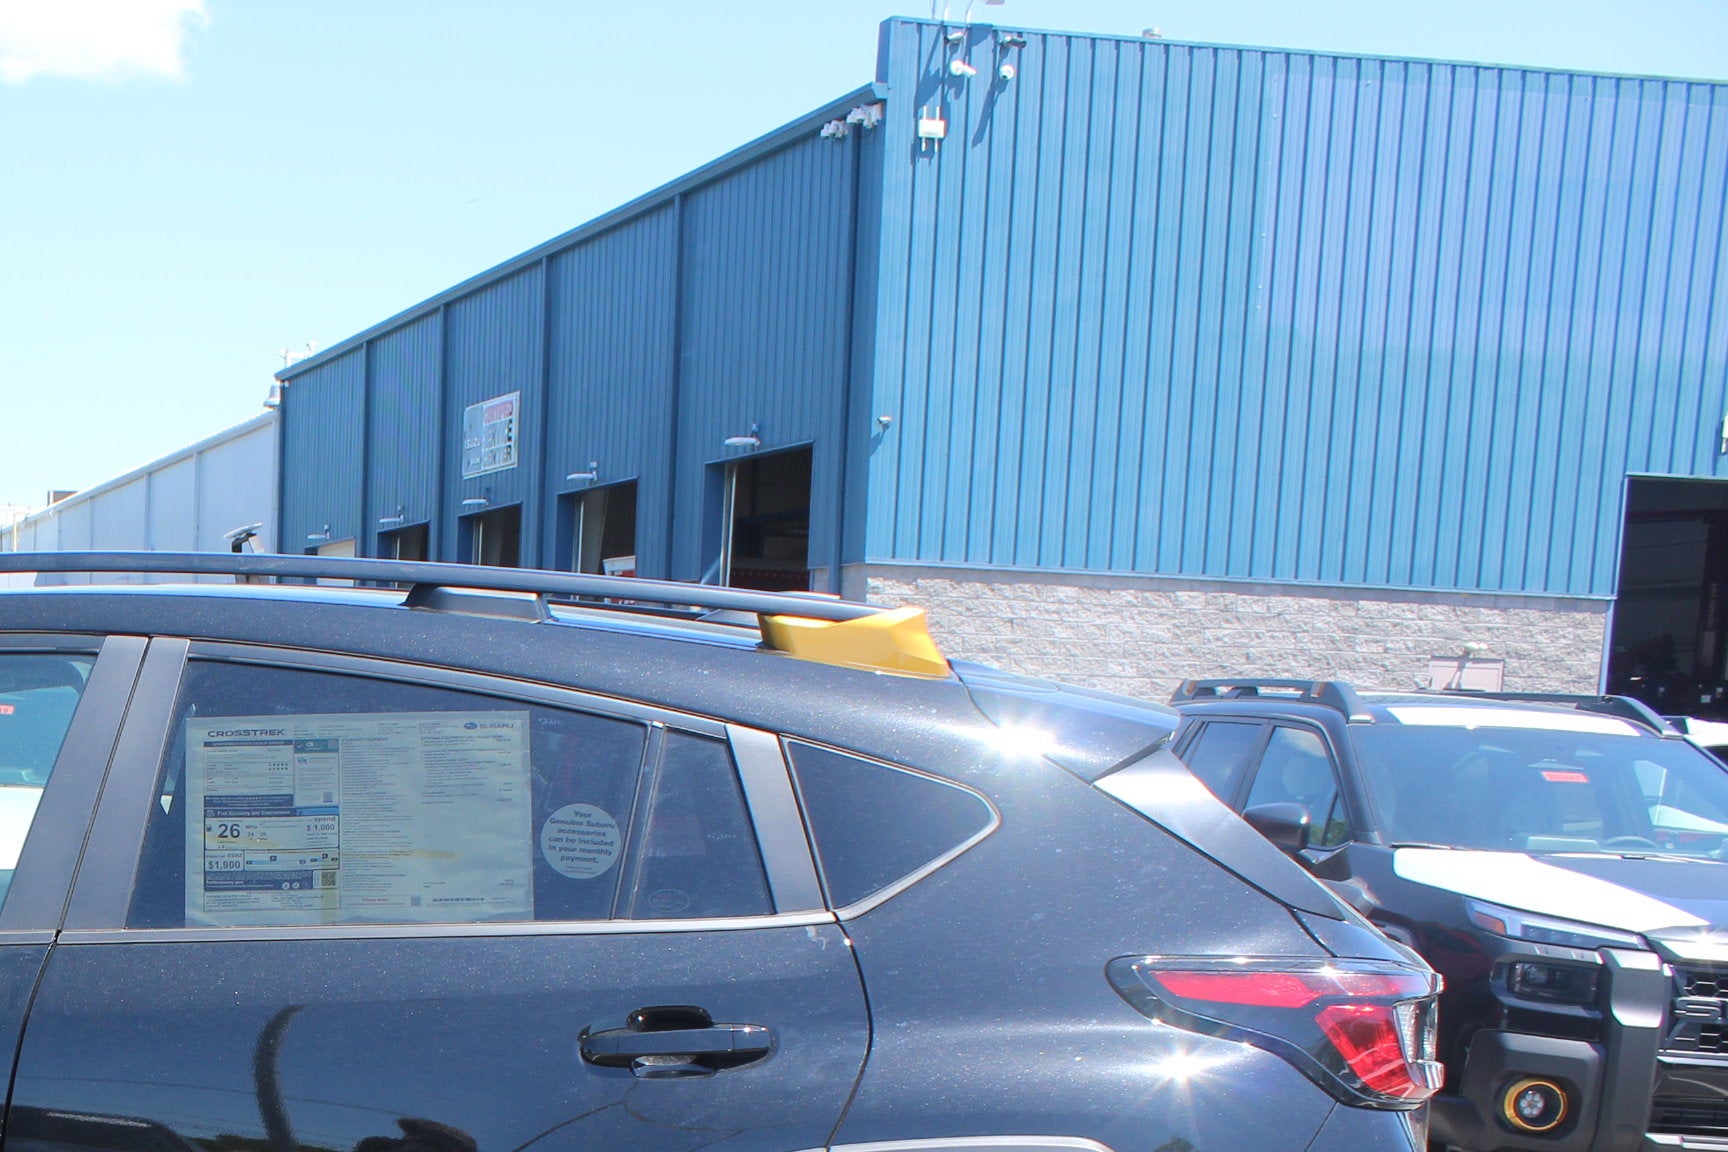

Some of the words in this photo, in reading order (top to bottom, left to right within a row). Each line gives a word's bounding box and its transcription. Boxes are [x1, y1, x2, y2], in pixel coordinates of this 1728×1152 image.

[207, 729, 285, 738] CROSSTREK
[549, 818, 584, 826] Genuine
[585, 820, 615, 829] Subaru
[217, 823, 241, 839] 26
[557, 828, 607, 837] accessories
[578, 837, 614, 846] included
[579, 848, 612, 856] monthly
[208, 860, 241, 870] $1,900
